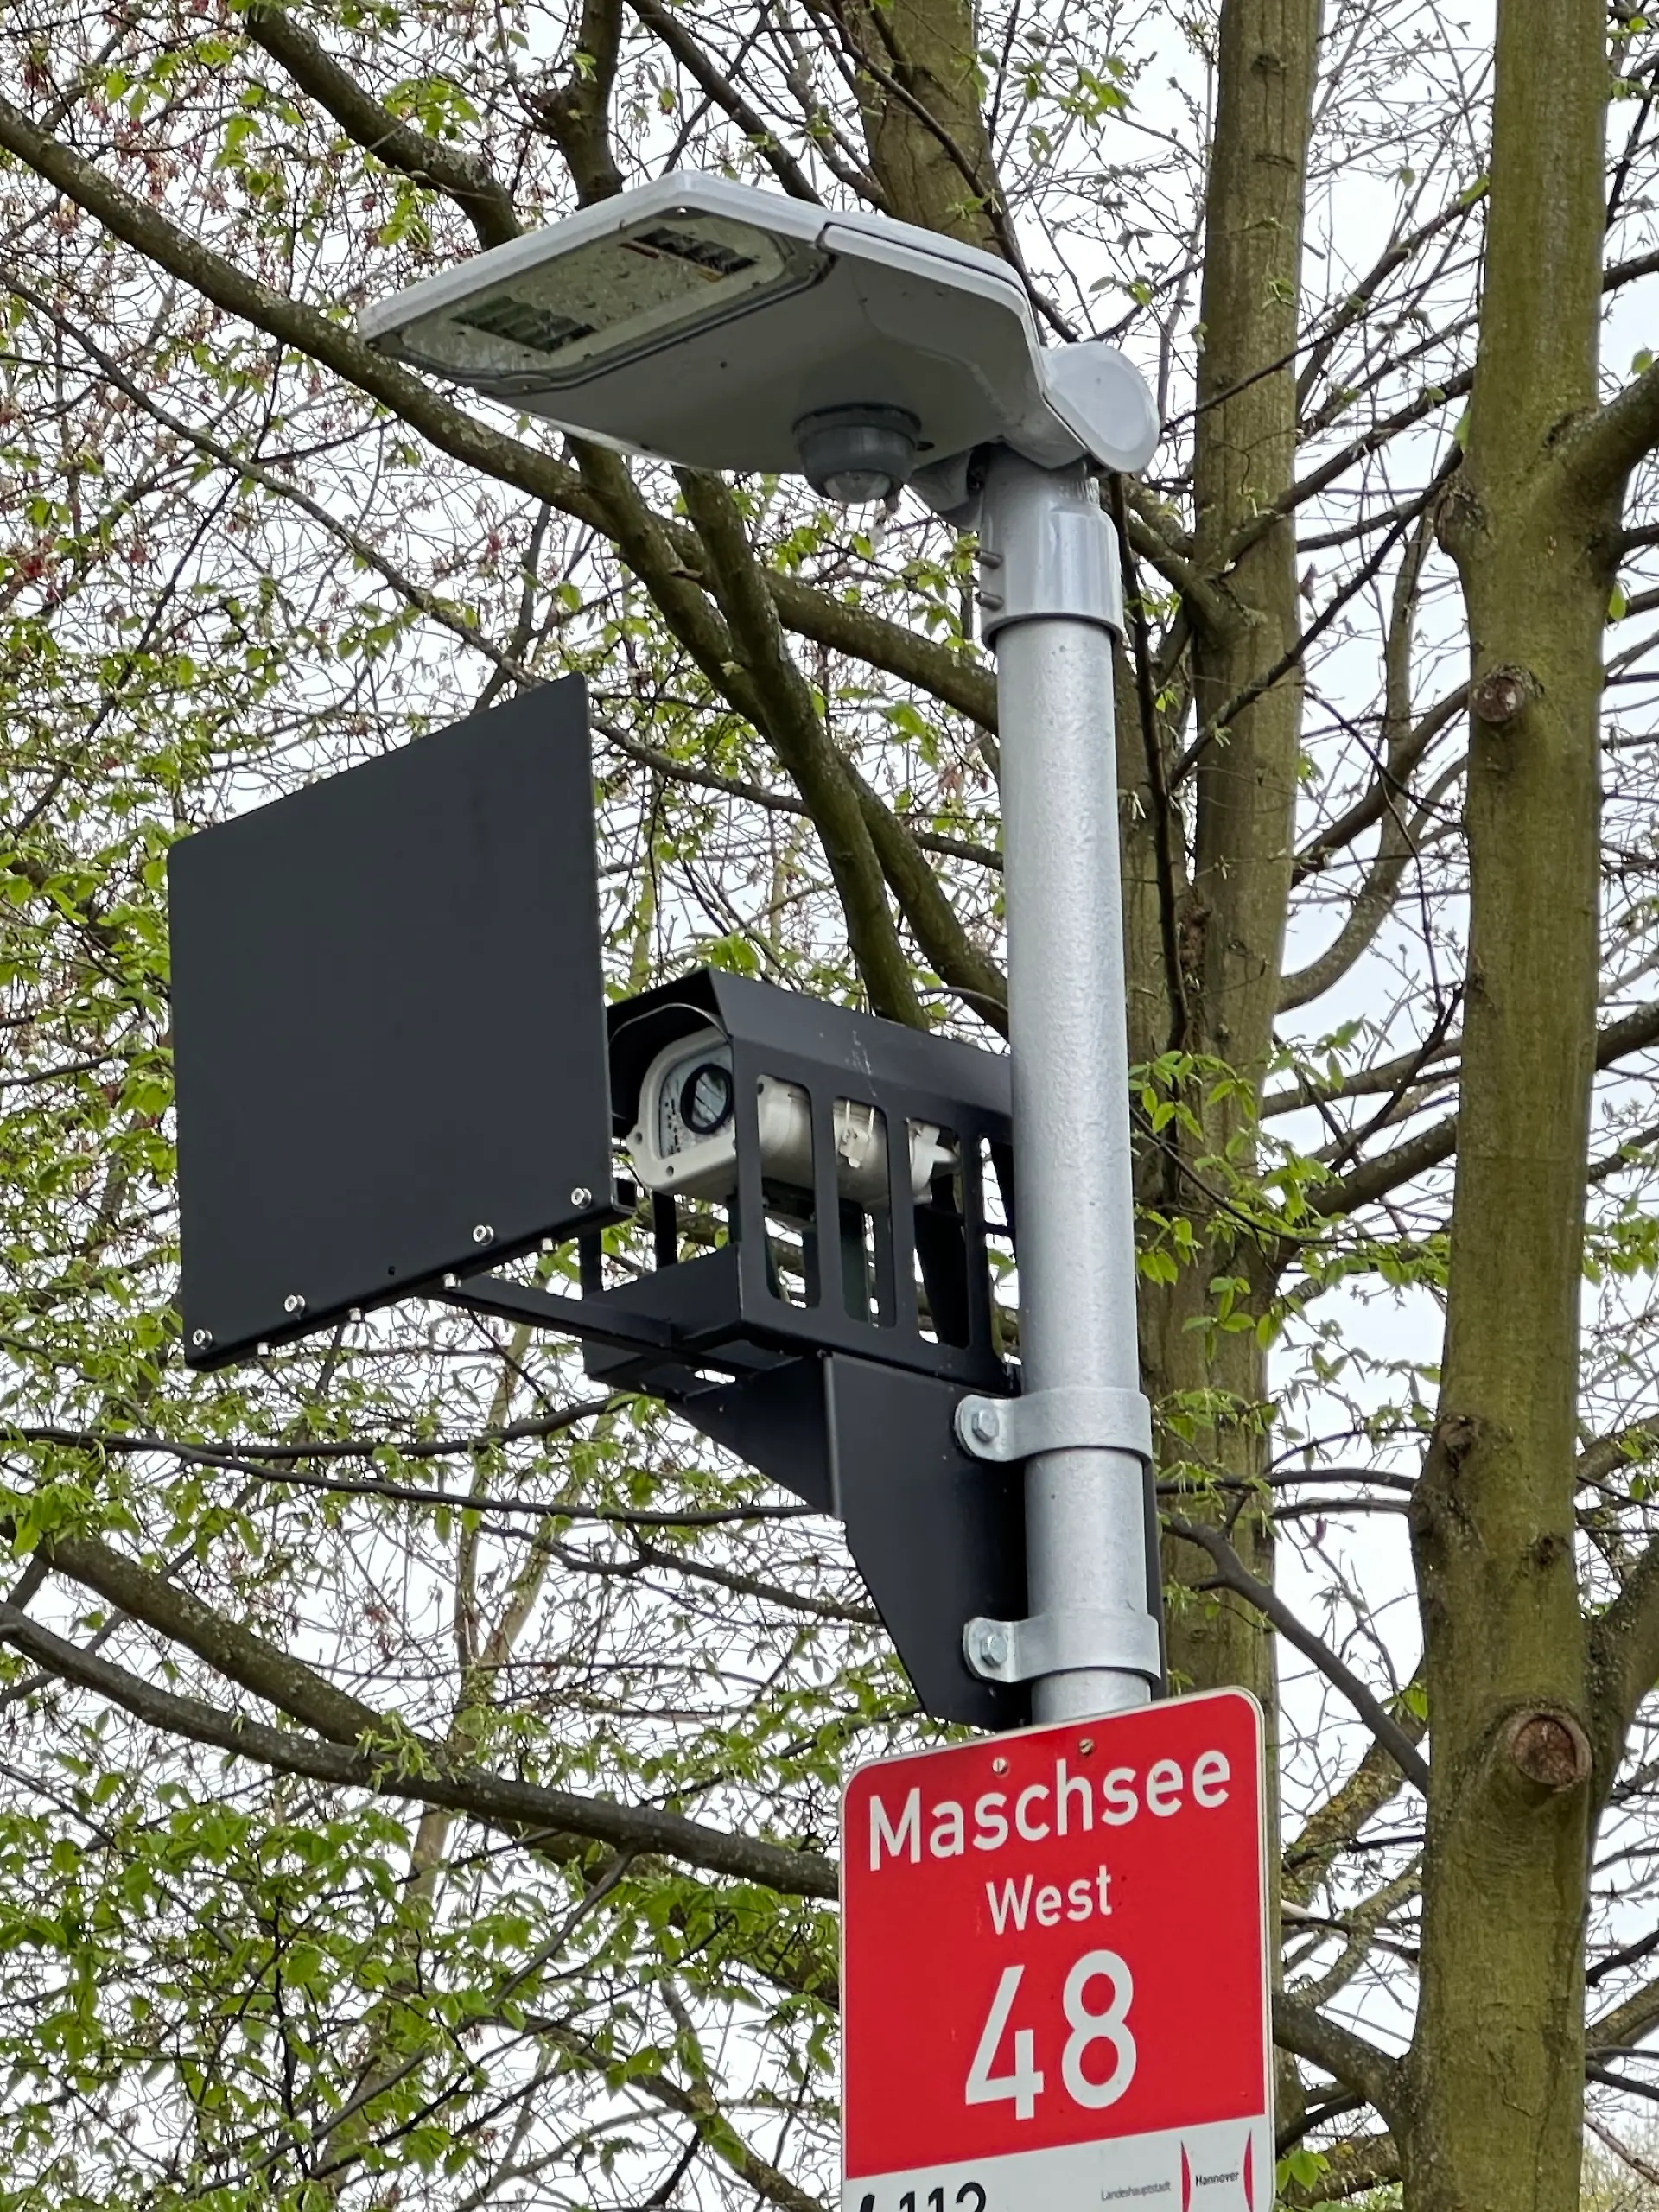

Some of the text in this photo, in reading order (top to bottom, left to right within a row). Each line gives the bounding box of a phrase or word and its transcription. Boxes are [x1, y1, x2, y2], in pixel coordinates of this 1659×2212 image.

[869, 1750, 1230, 1872] Maschsee
[986, 1865, 1112, 1935] West
[965, 1949, 1137, 2120] 48
[1101, 2171, 1239, 2202] Landeshauptstadt Hannover
